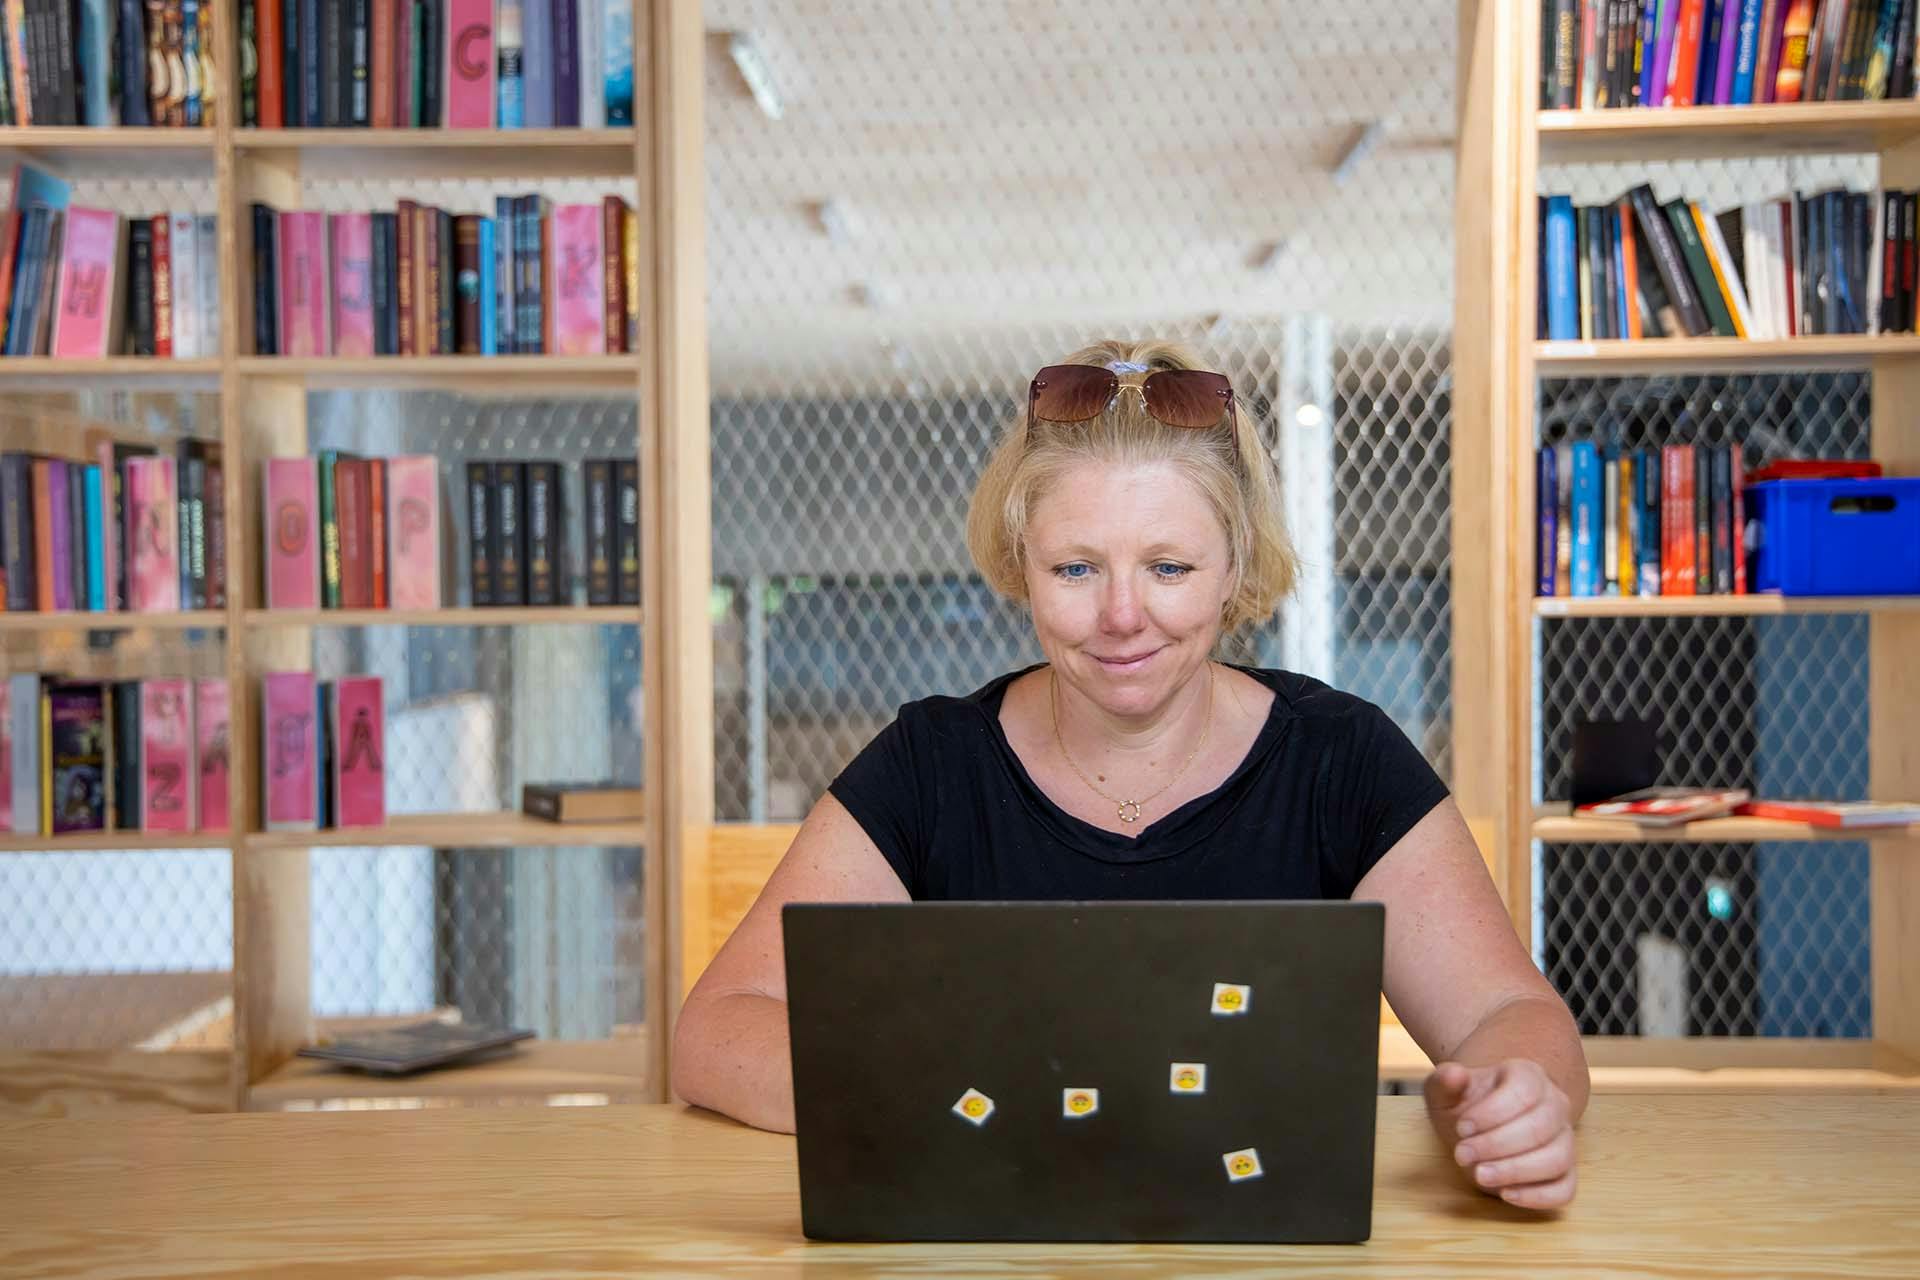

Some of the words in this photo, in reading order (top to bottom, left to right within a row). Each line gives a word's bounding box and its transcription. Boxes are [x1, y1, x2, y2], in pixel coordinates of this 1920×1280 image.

[454, 22, 491, 82] C
[341, 256, 371, 313] J
[560, 243, 598, 300] K
[276, 498, 309, 558] O
[397, 497, 431, 556] P
